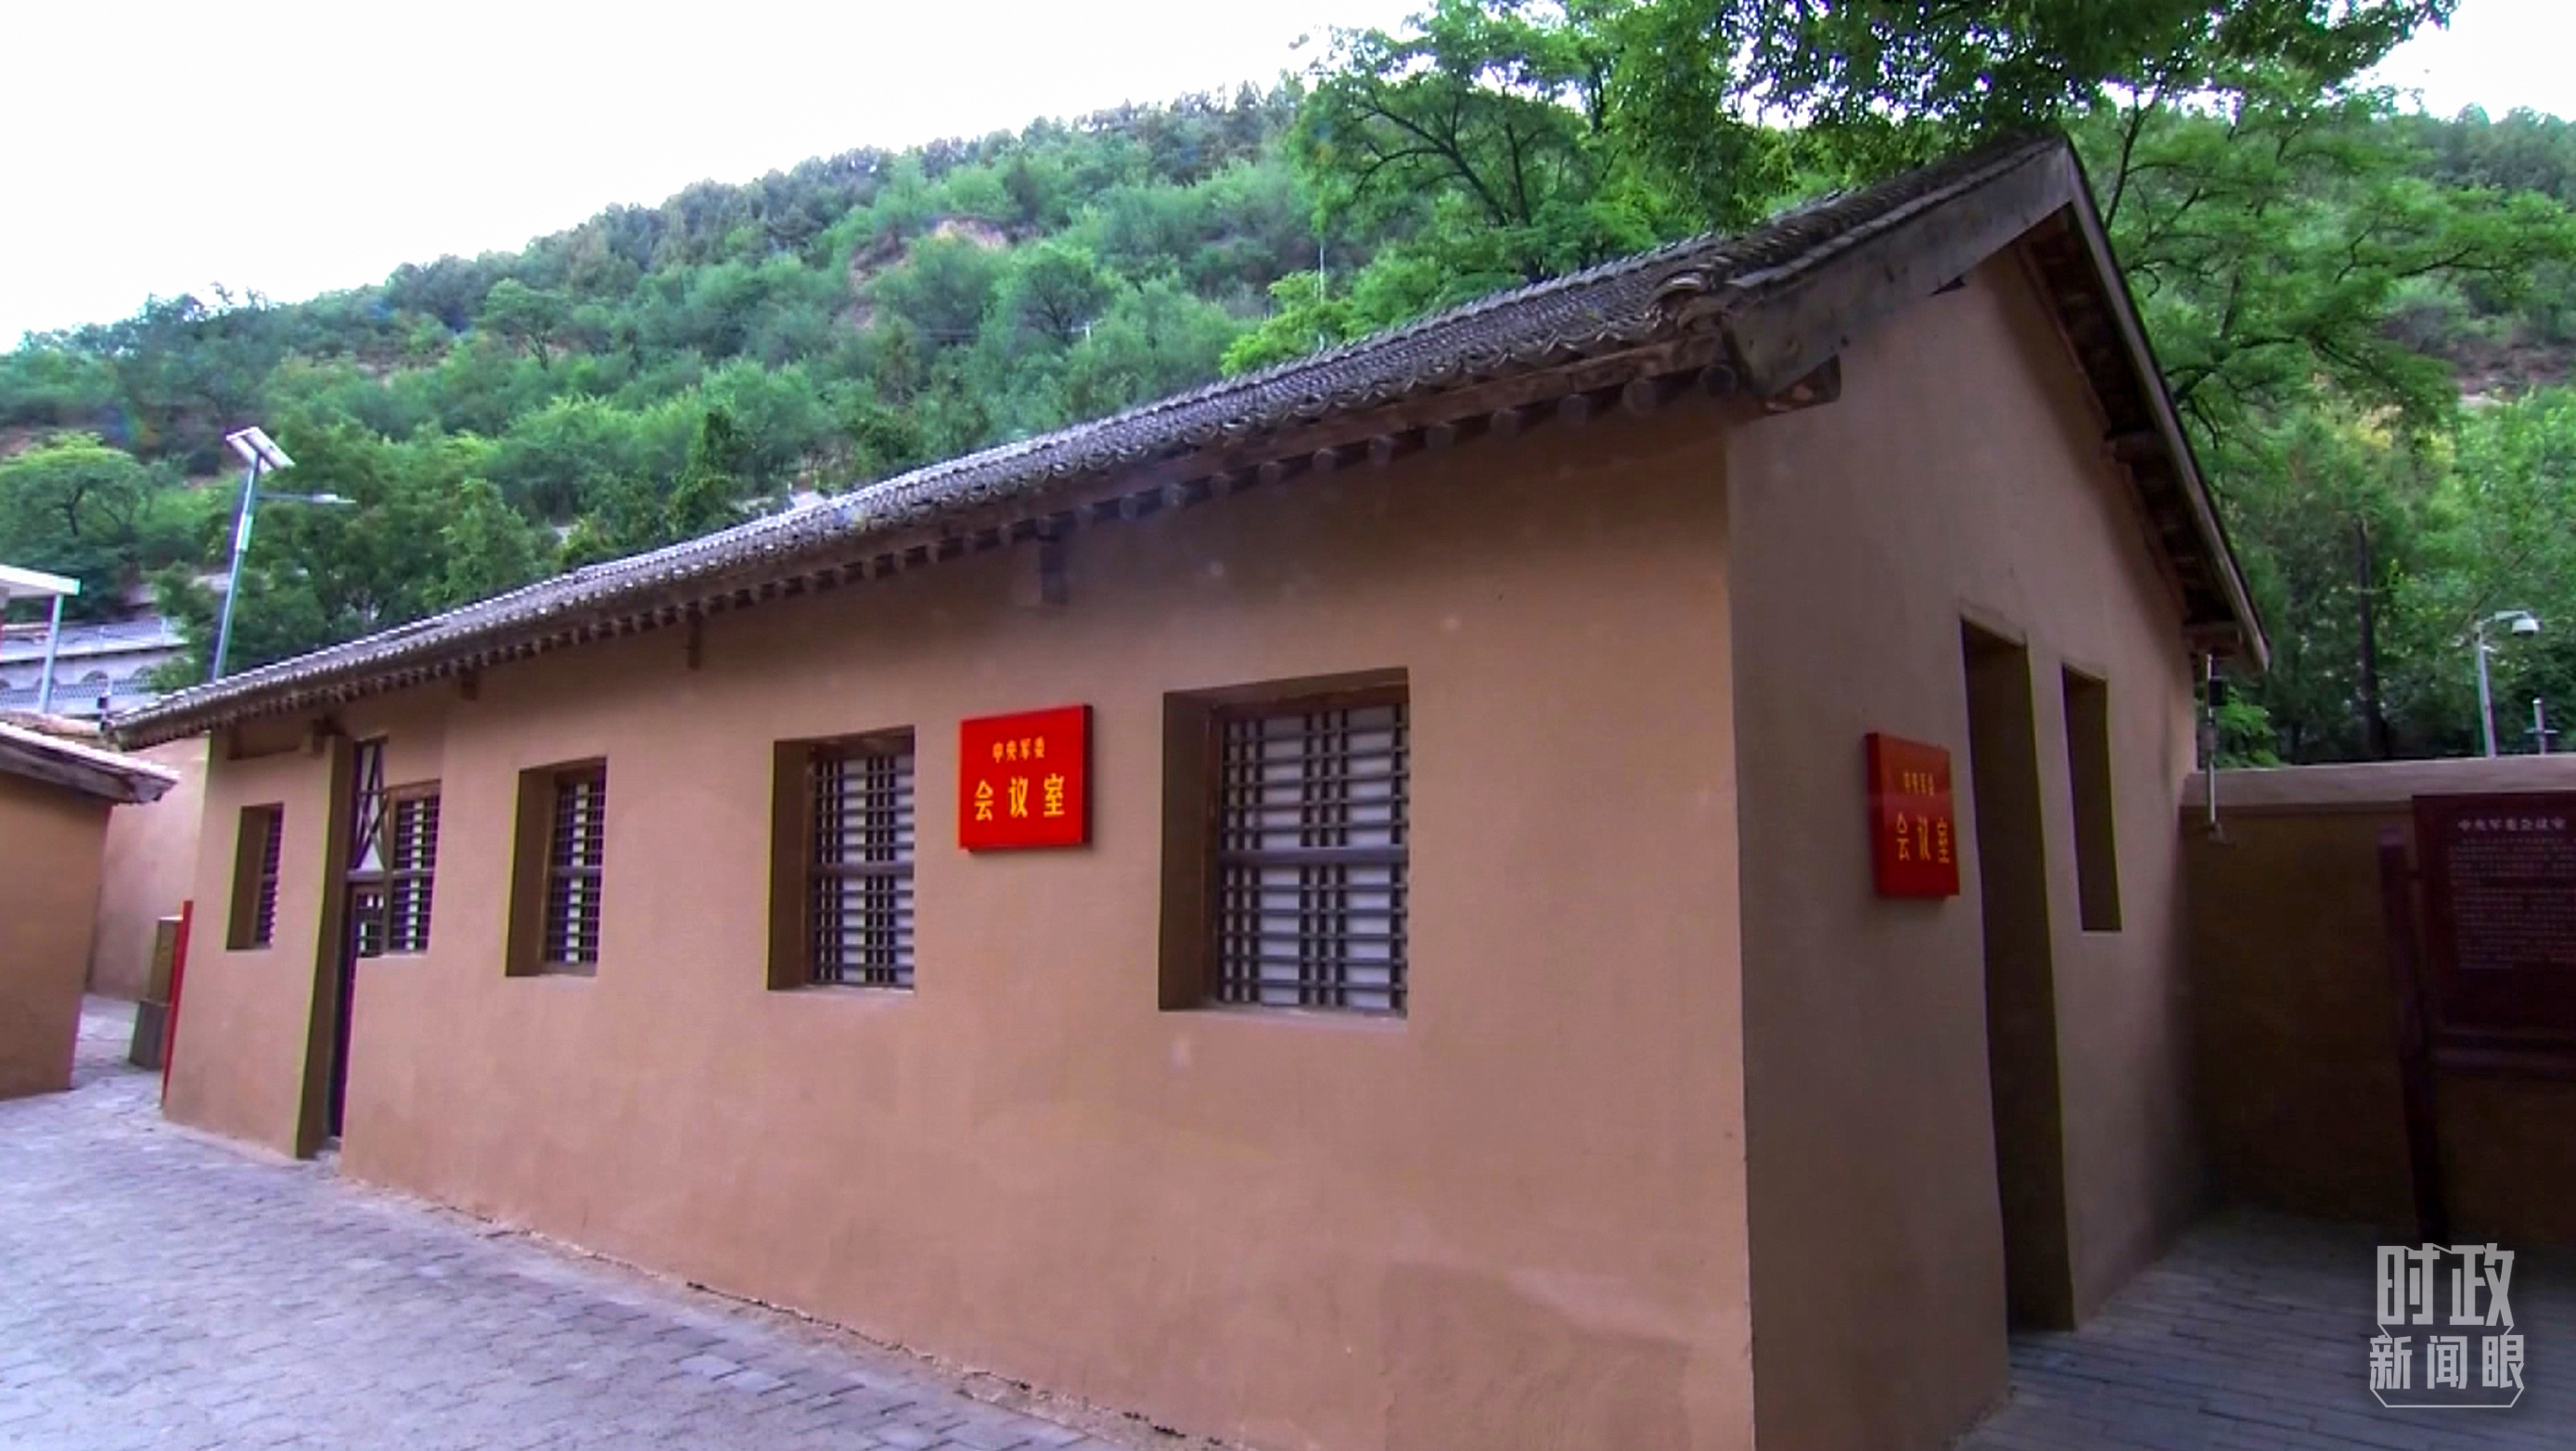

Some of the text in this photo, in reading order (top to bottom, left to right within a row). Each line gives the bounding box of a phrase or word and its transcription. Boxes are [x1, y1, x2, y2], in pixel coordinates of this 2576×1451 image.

[974, 773, 1065, 822] 会议室
[1896, 812, 1950, 864] 会议室
